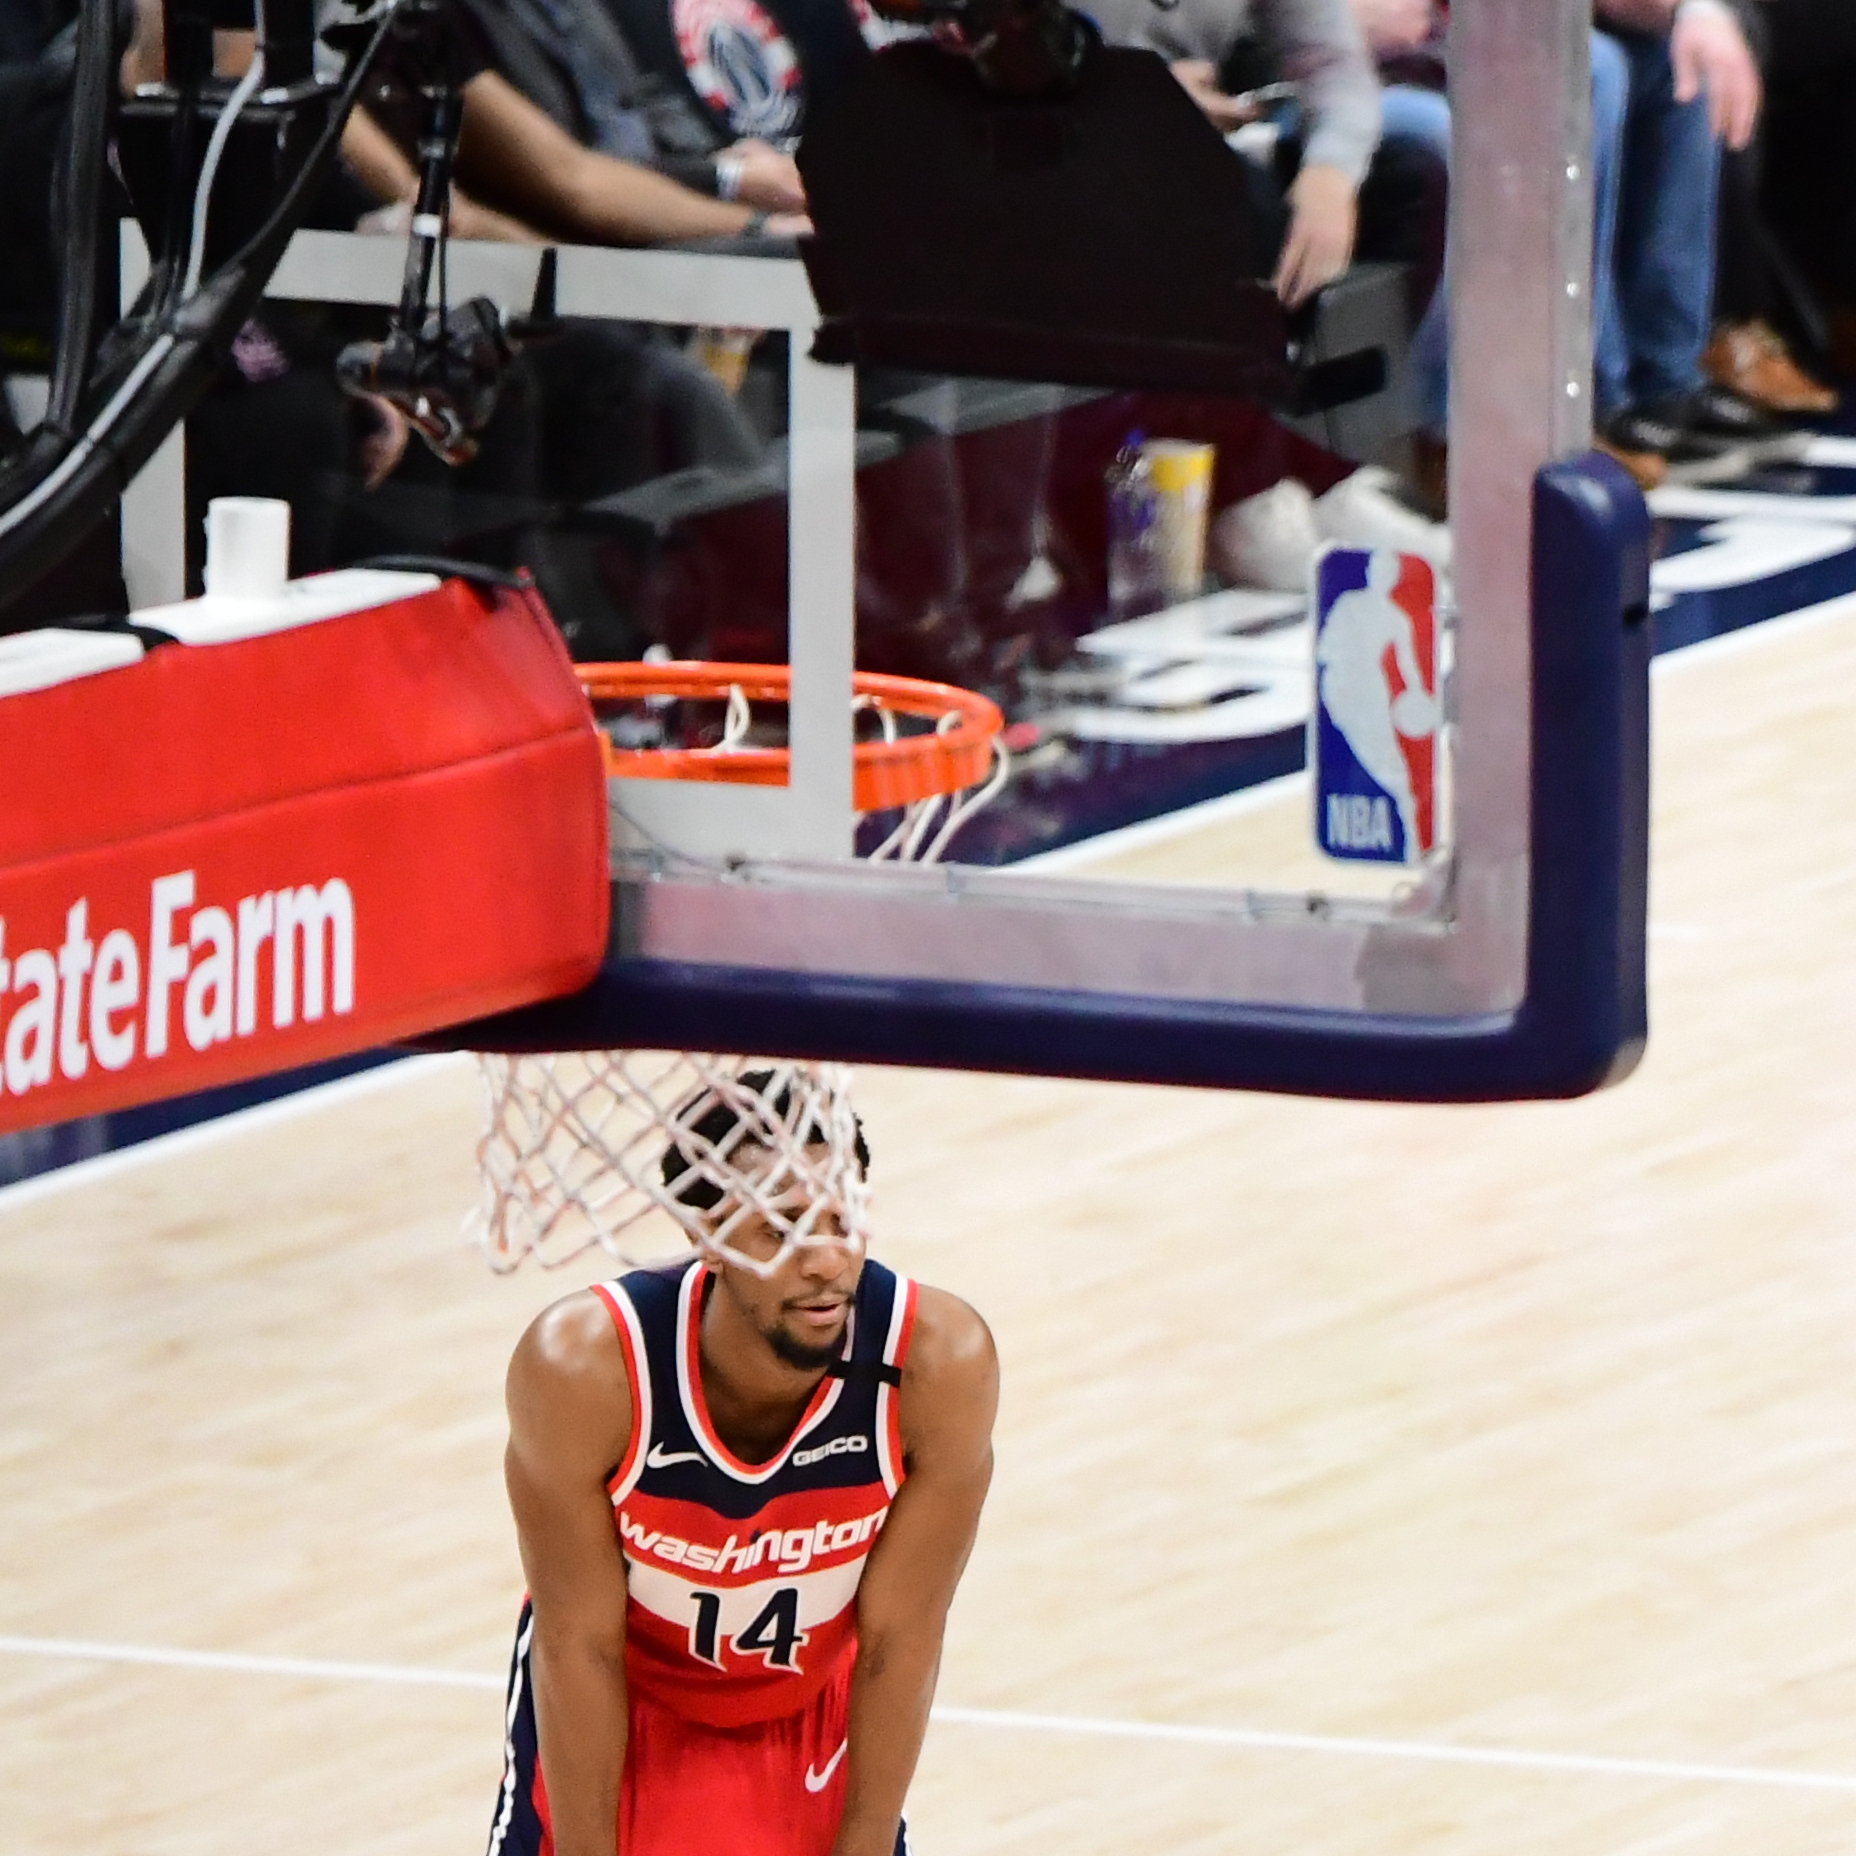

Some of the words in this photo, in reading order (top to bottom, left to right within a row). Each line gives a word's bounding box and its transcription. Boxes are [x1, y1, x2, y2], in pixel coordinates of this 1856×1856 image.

[1326, 793, 1393, 848] NBA
[792, 1435, 868, 1467] GEICO
[620, 1506, 889, 1574] washington
[688, 1586, 810, 1676] 14
